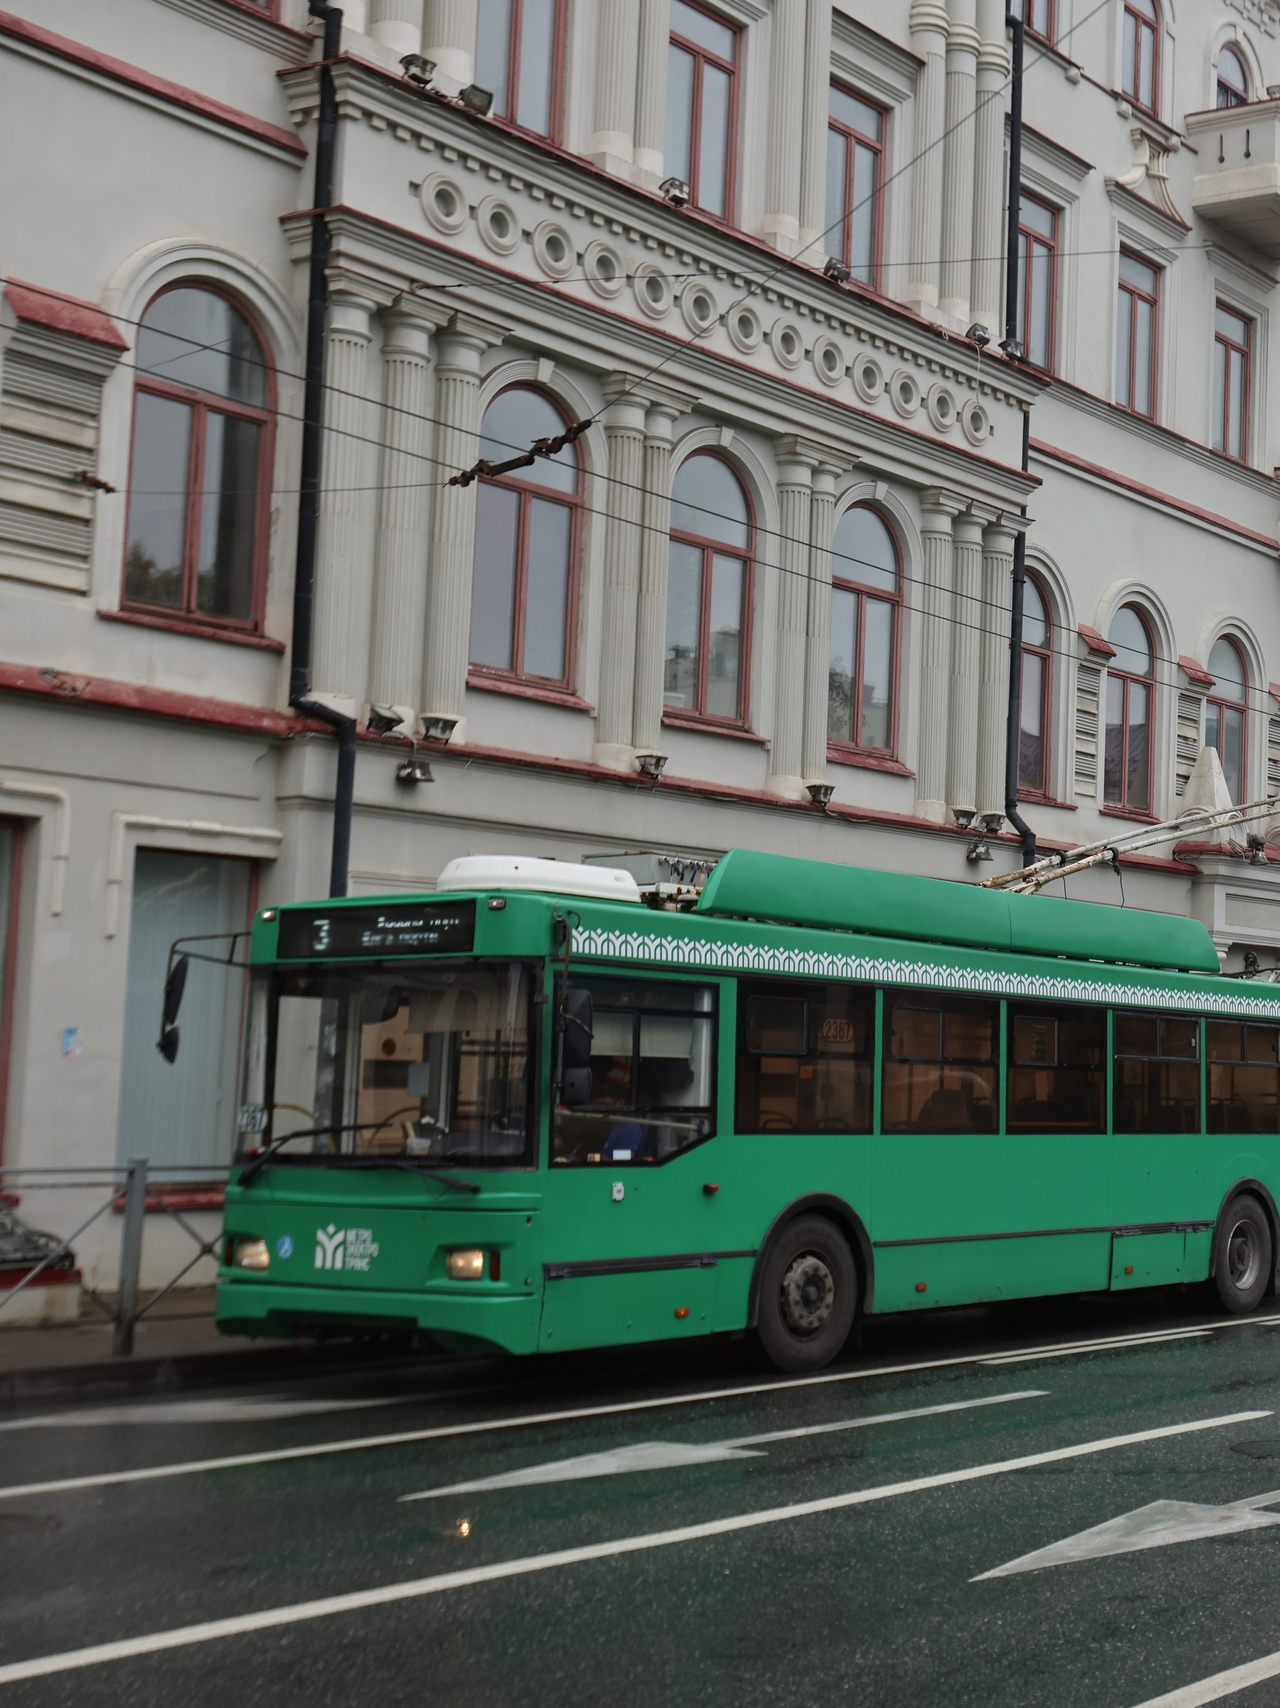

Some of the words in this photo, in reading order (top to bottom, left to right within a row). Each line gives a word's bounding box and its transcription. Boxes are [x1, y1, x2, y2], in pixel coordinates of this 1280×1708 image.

[312, 919, 330, 950] 3
[826, 1020, 851, 1040] 2367
[346, 1228, 372, 1243] МЕТРО
[345, 1257, 370, 1272] ТРАНС
